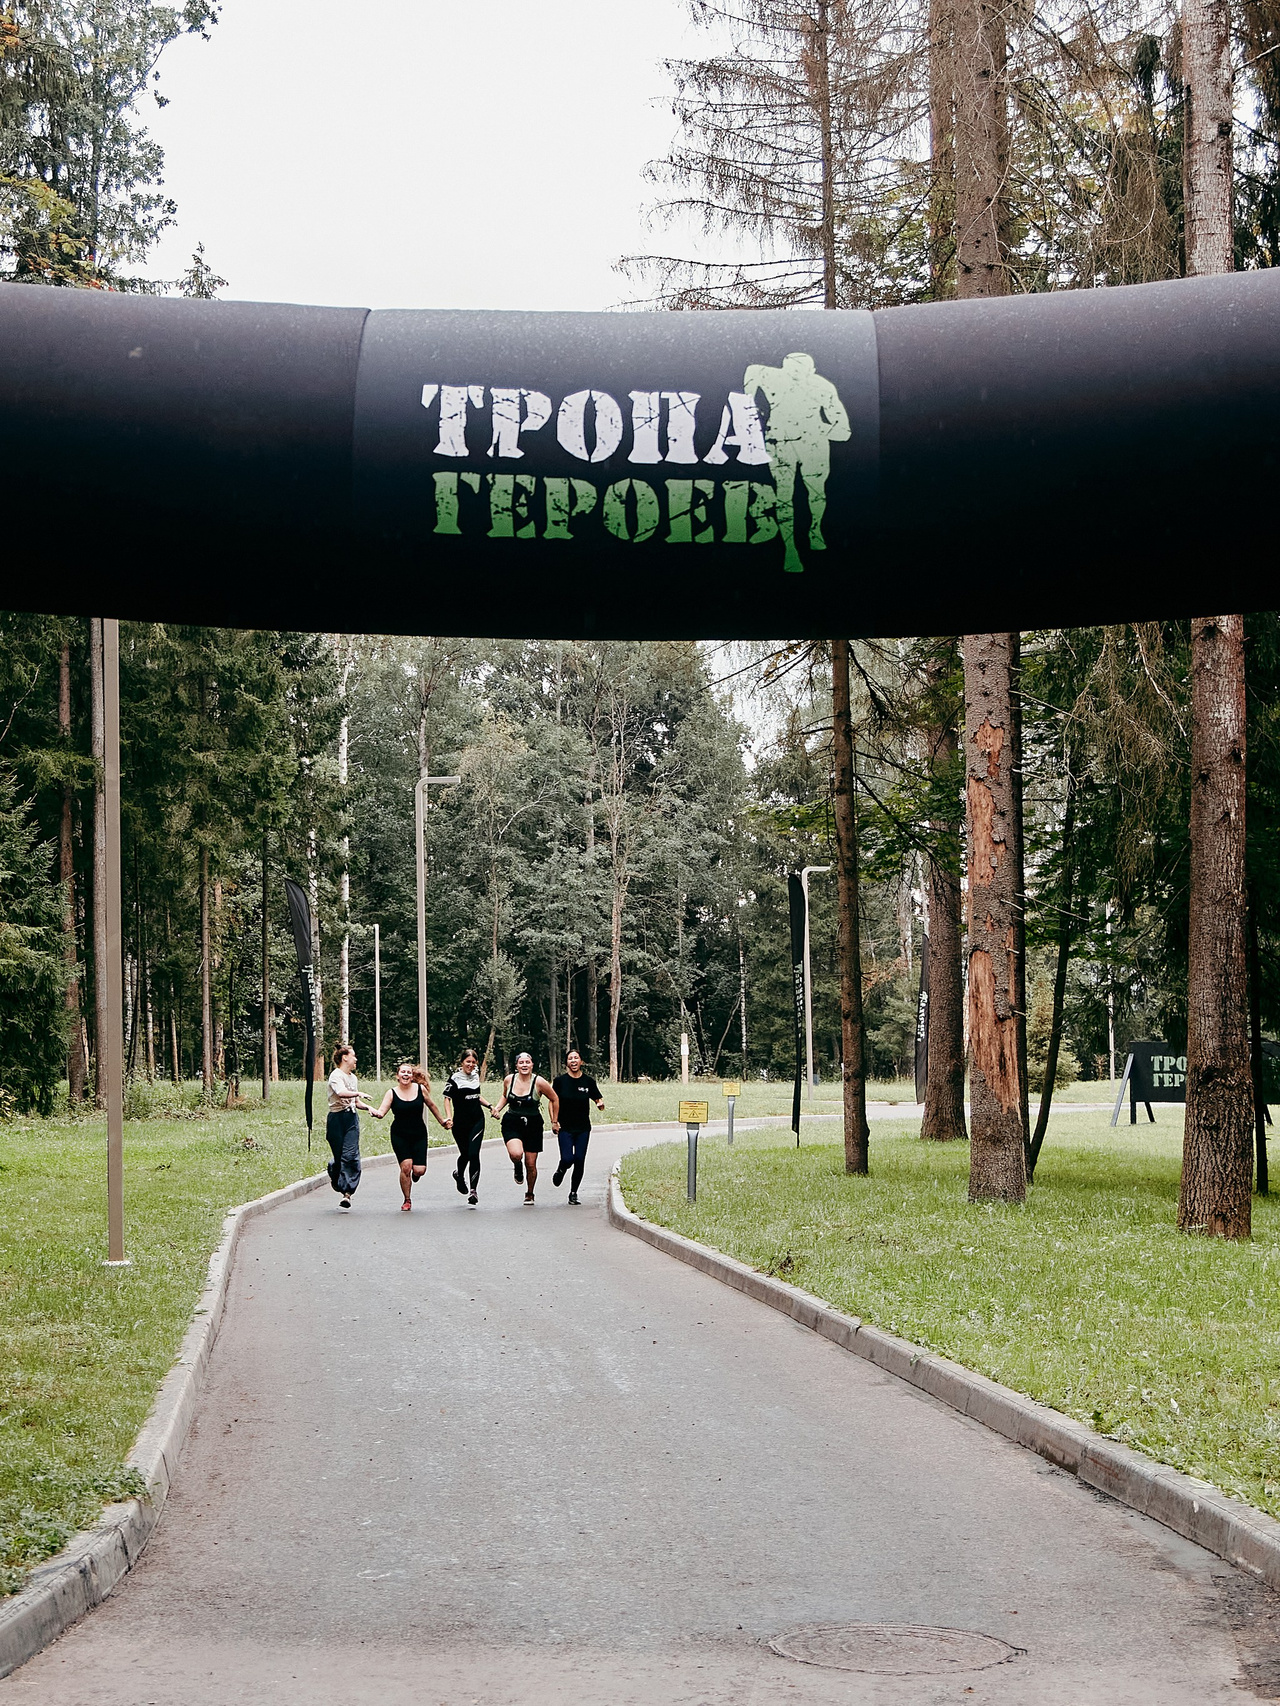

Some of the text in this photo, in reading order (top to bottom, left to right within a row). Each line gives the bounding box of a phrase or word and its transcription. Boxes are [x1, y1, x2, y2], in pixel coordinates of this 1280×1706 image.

[421, 384, 773, 465] ТРОПА
[432, 471, 779, 544] ГЕРОЕВ
[1150, 1055, 1188, 1072] ТРО
[1152, 1073, 1187, 1087] ГЕР
